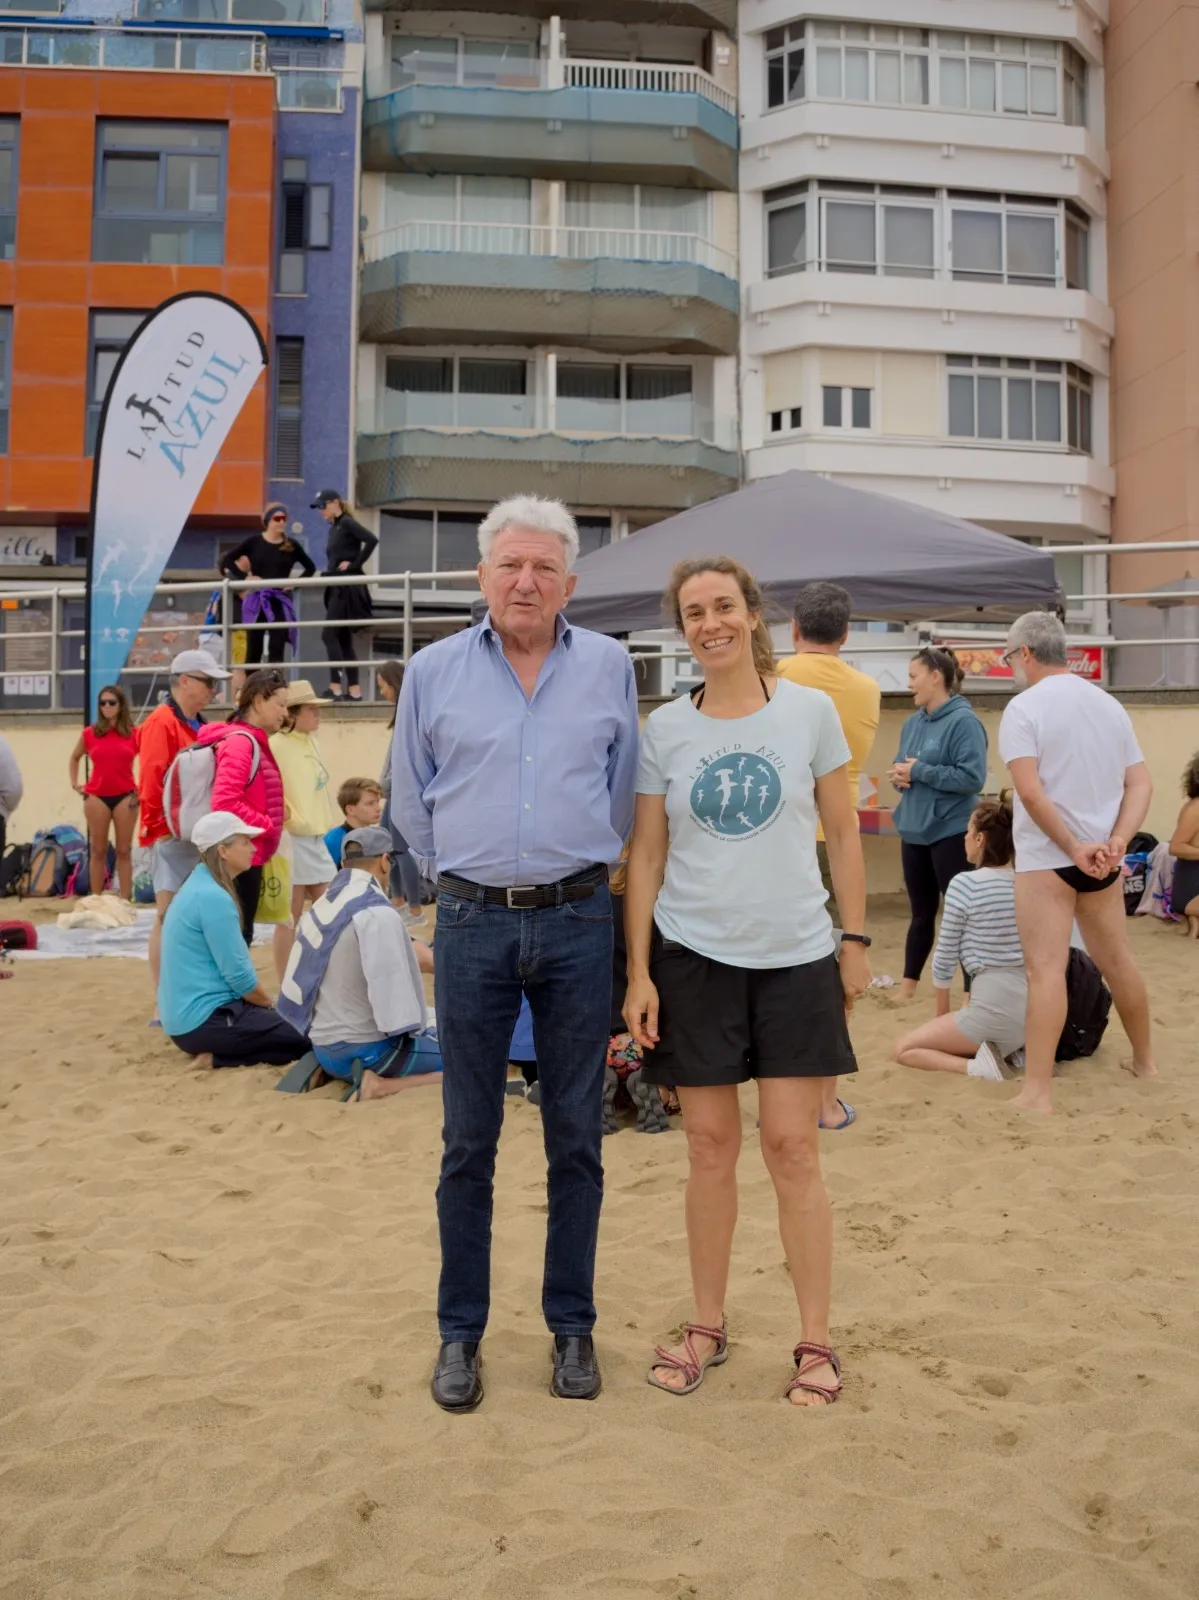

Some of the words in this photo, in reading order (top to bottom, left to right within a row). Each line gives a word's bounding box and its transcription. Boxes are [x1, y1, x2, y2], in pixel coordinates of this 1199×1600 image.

[125, 331, 205, 460] LATITUD
[159, 351, 250, 478] AZUL
[688, 743, 742, 780] LATITUD
[756, 745, 786, 773] AZUL
